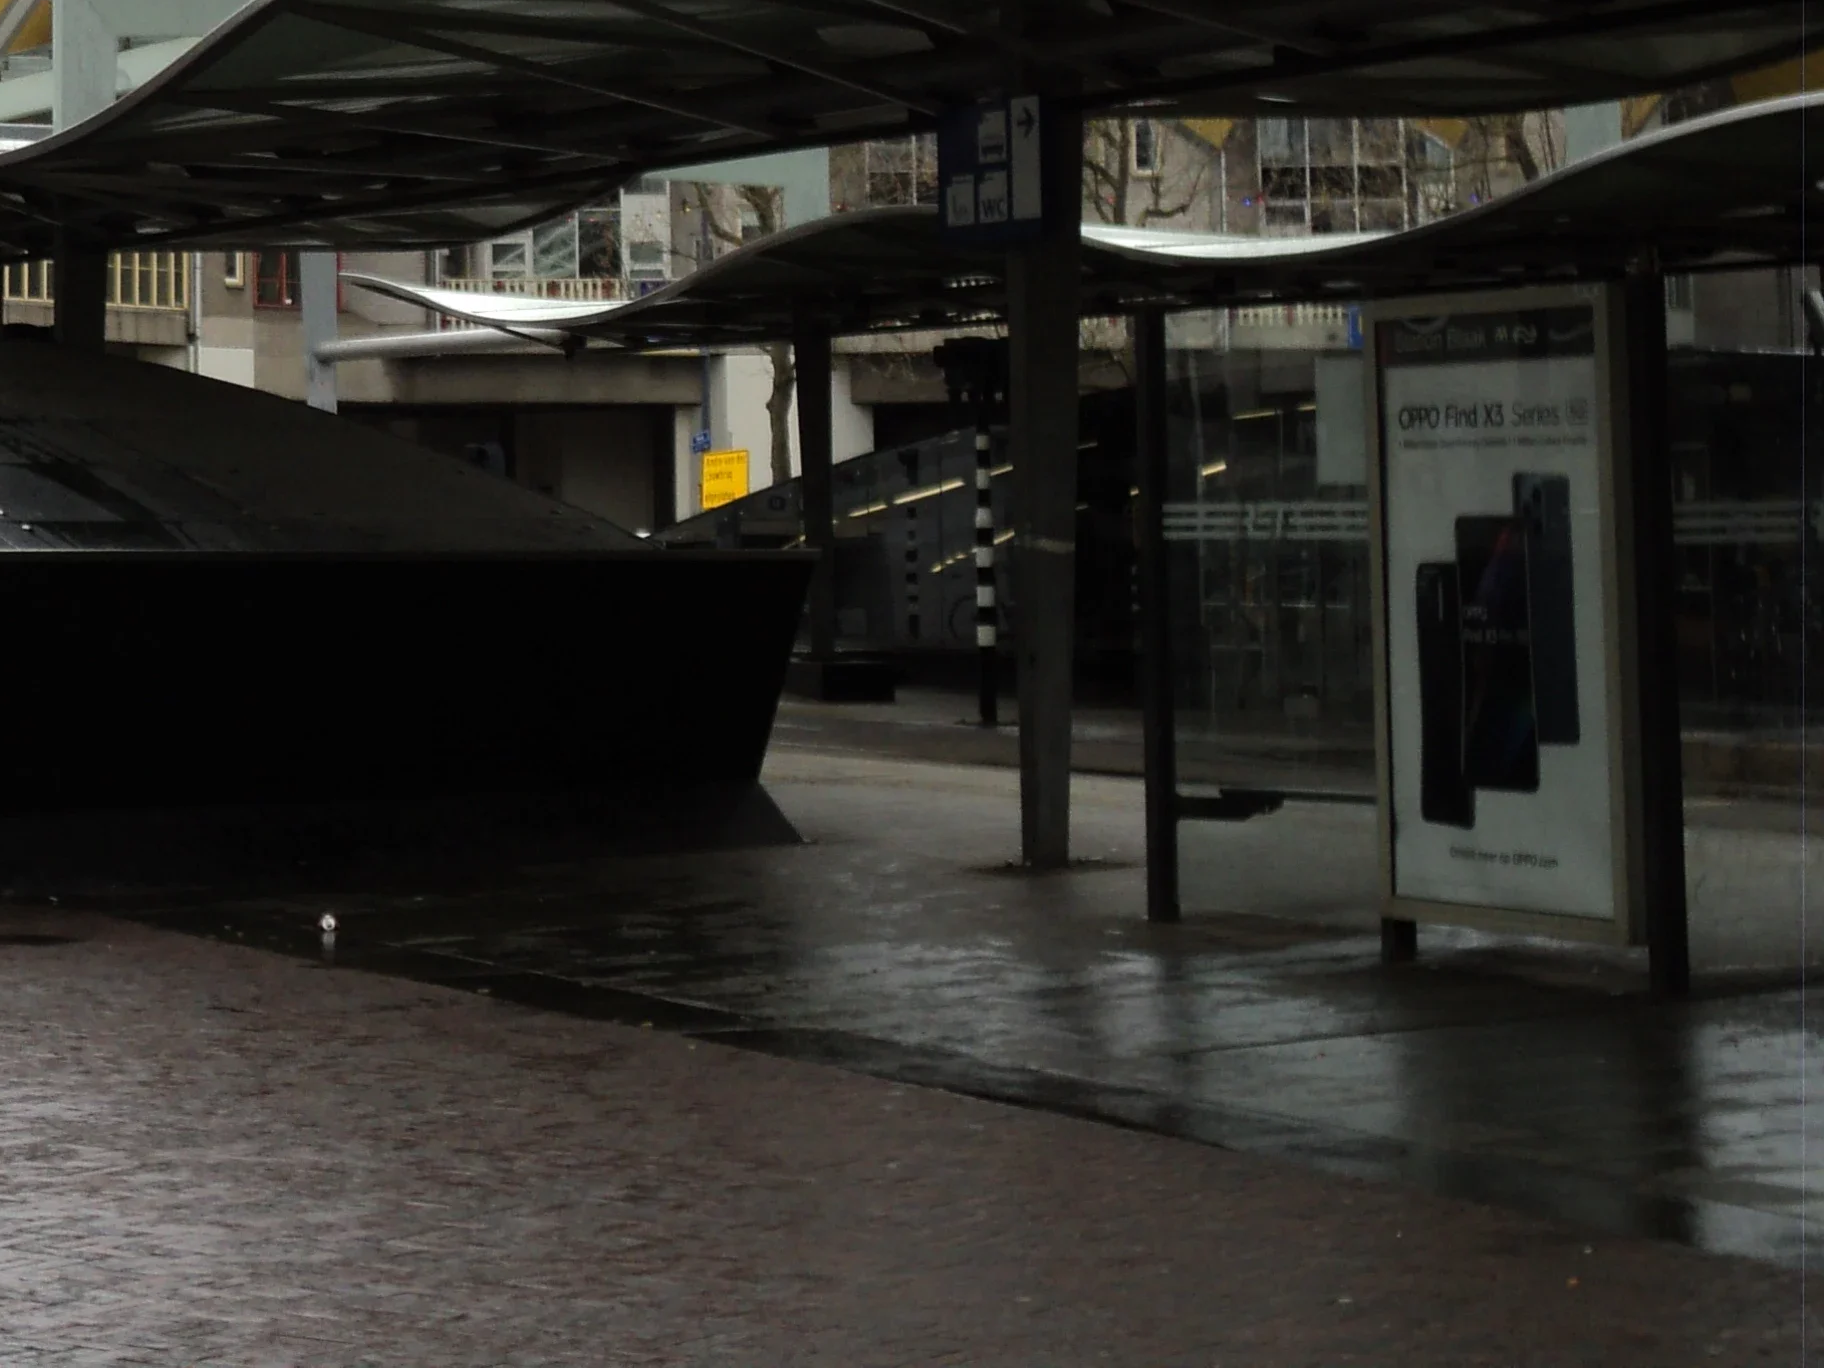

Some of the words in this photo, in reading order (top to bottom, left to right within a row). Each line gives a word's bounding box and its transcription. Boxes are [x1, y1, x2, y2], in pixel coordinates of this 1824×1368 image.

[981, 197, 1005, 218] WC
[1399, 404, 1440, 430] OPPO
[1445, 403, 1477, 428] Find
[1483, 403, 1505, 429] X3
[1511, 401, 1560, 428] Series
